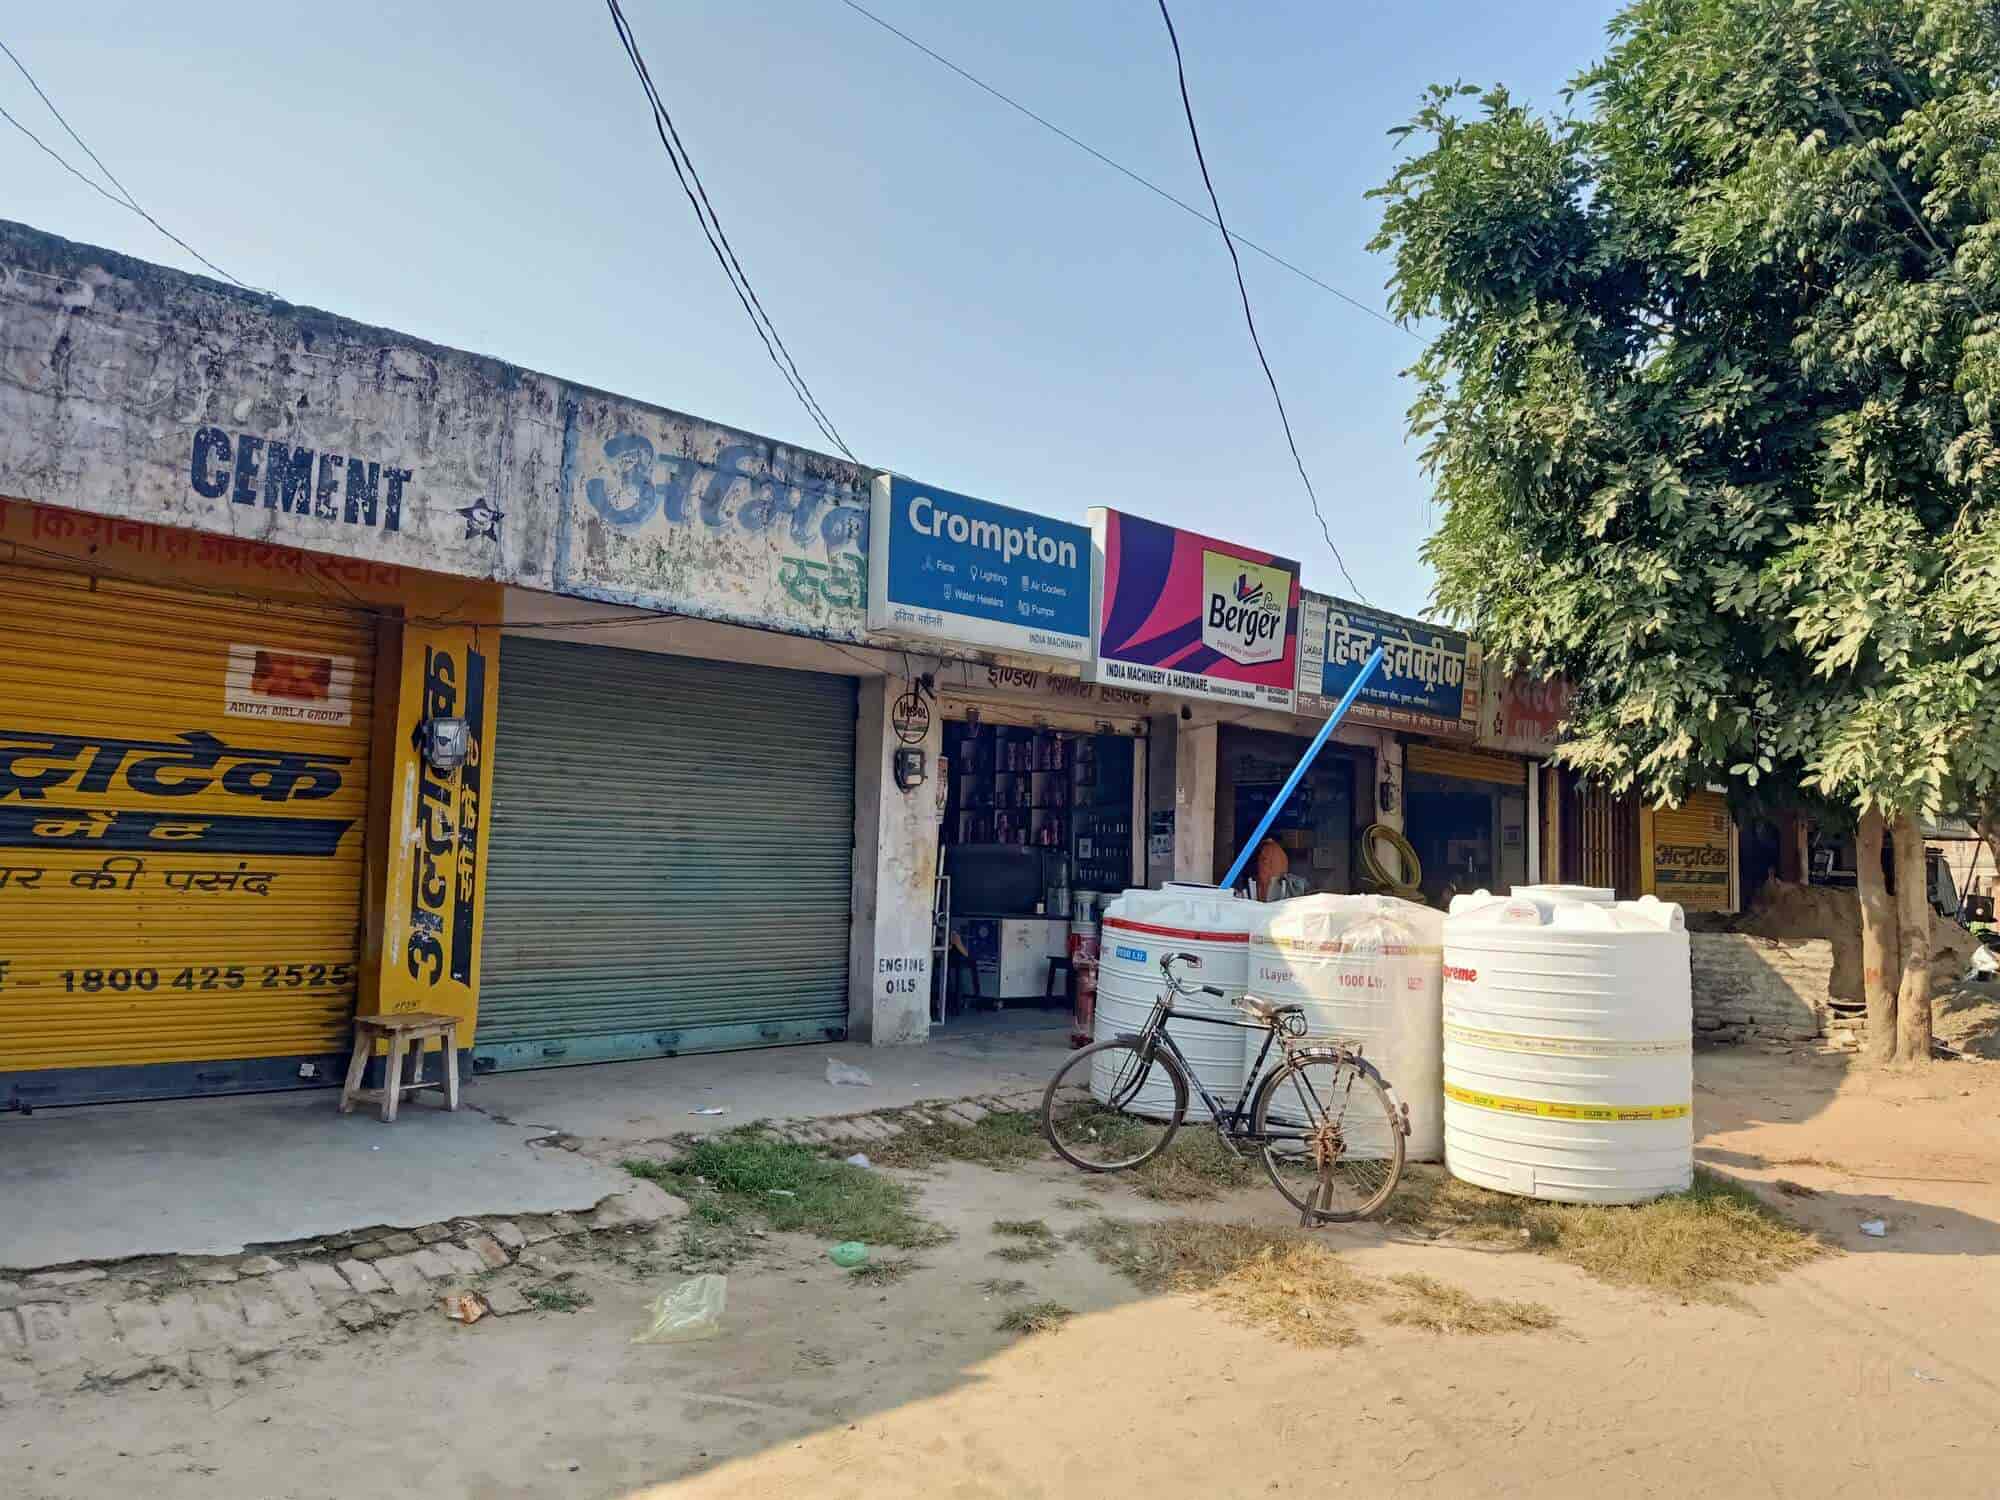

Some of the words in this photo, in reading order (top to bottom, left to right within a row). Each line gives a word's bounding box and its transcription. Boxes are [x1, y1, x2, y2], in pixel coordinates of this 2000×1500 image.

[191, 427, 411, 532] CEMENT
[908, 496, 1077, 569] Crompton
[1208, 593, 1281, 647] Berger
[1106, 663, 1126, 680] INDIA
[1126, 667, 1165, 687] MACHINERY
[307, 709, 344, 721] GROUP
[70, 857, 148, 891] की
[163, 862, 279, 897] पसंद
[60, 967, 159, 993] 1800
[172, 967, 246, 991] 425
[261, 963, 354, 988] 2525
[879, 958, 926, 973] ENGINE
[886, 978, 916, 994] OILS
